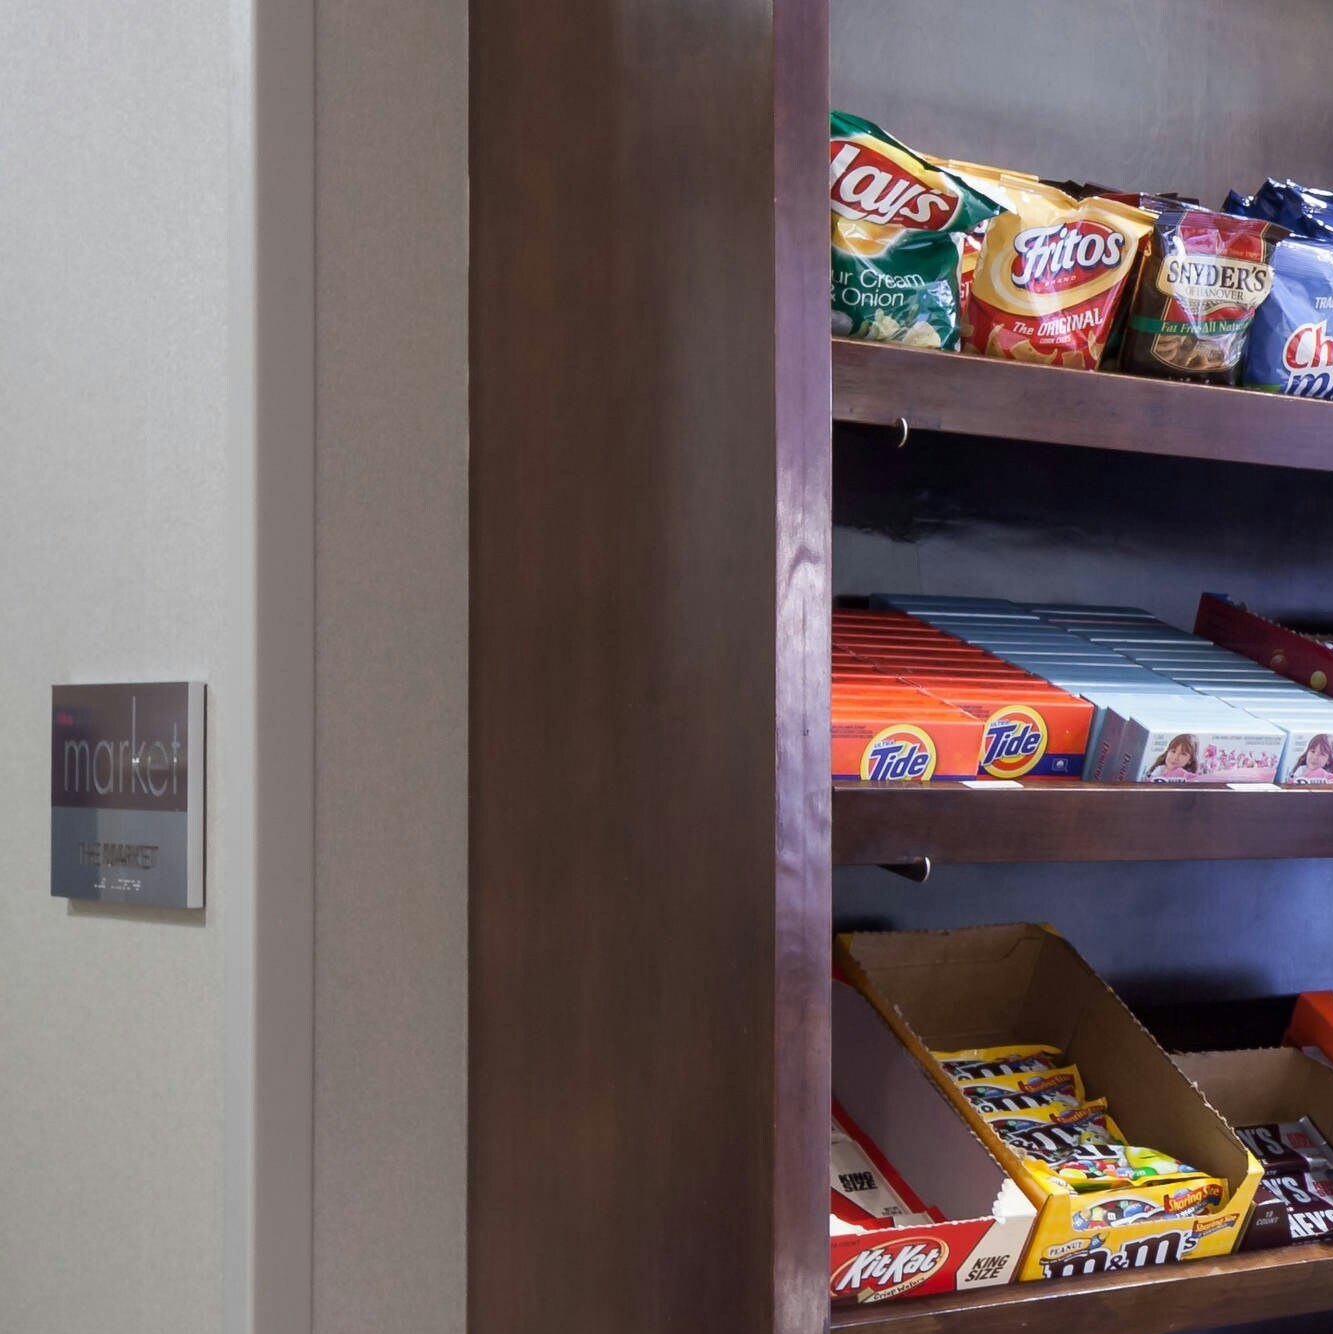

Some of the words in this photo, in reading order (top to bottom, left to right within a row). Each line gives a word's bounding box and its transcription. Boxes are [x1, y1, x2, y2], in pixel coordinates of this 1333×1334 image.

[1012, 221, 1125, 287] Fritos
[860, 269, 926, 289] Cream
[1166, 260, 1268, 293] SNYDER'S
[842, 287, 904, 307] Onion
[1197, 286, 1245, 301] HANOVER
[1012, 321, 1034, 335] The
[1036, 307, 1103, 336] ORIGINAL
[63, 696, 182, 797] market
[983, 722, 1042, 767] Tide
[870, 743, 930, 780] Tide
[838, 1171, 873, 1186] KING
[842, 1180, 878, 1193] SIZE
[1168, 1190, 1204, 1213] Sharing
[1050, 1240, 1083, 1255] PEANUT
[974, 1254, 1009, 1271] KING
[965, 1267, 1004, 1282] SIZE
